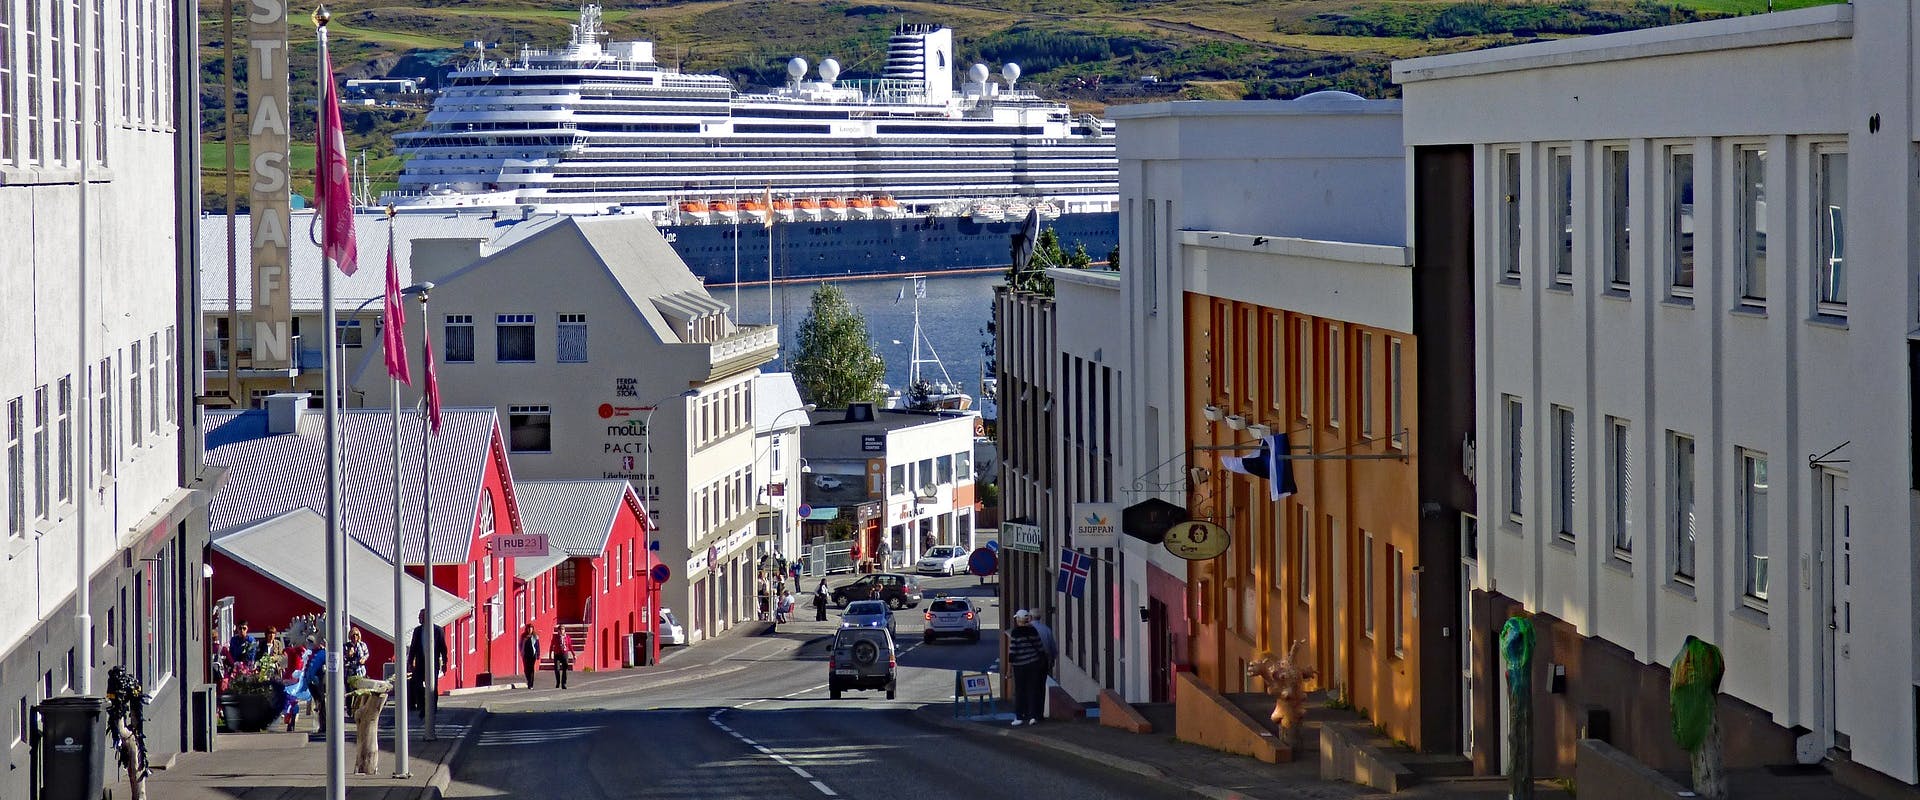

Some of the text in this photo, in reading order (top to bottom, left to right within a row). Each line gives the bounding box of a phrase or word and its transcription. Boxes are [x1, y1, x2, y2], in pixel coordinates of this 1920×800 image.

[607, 425, 650, 437] motus
[604, 443, 653, 454] PACTA
[1078, 525, 1114, 534] SJOPPAN
